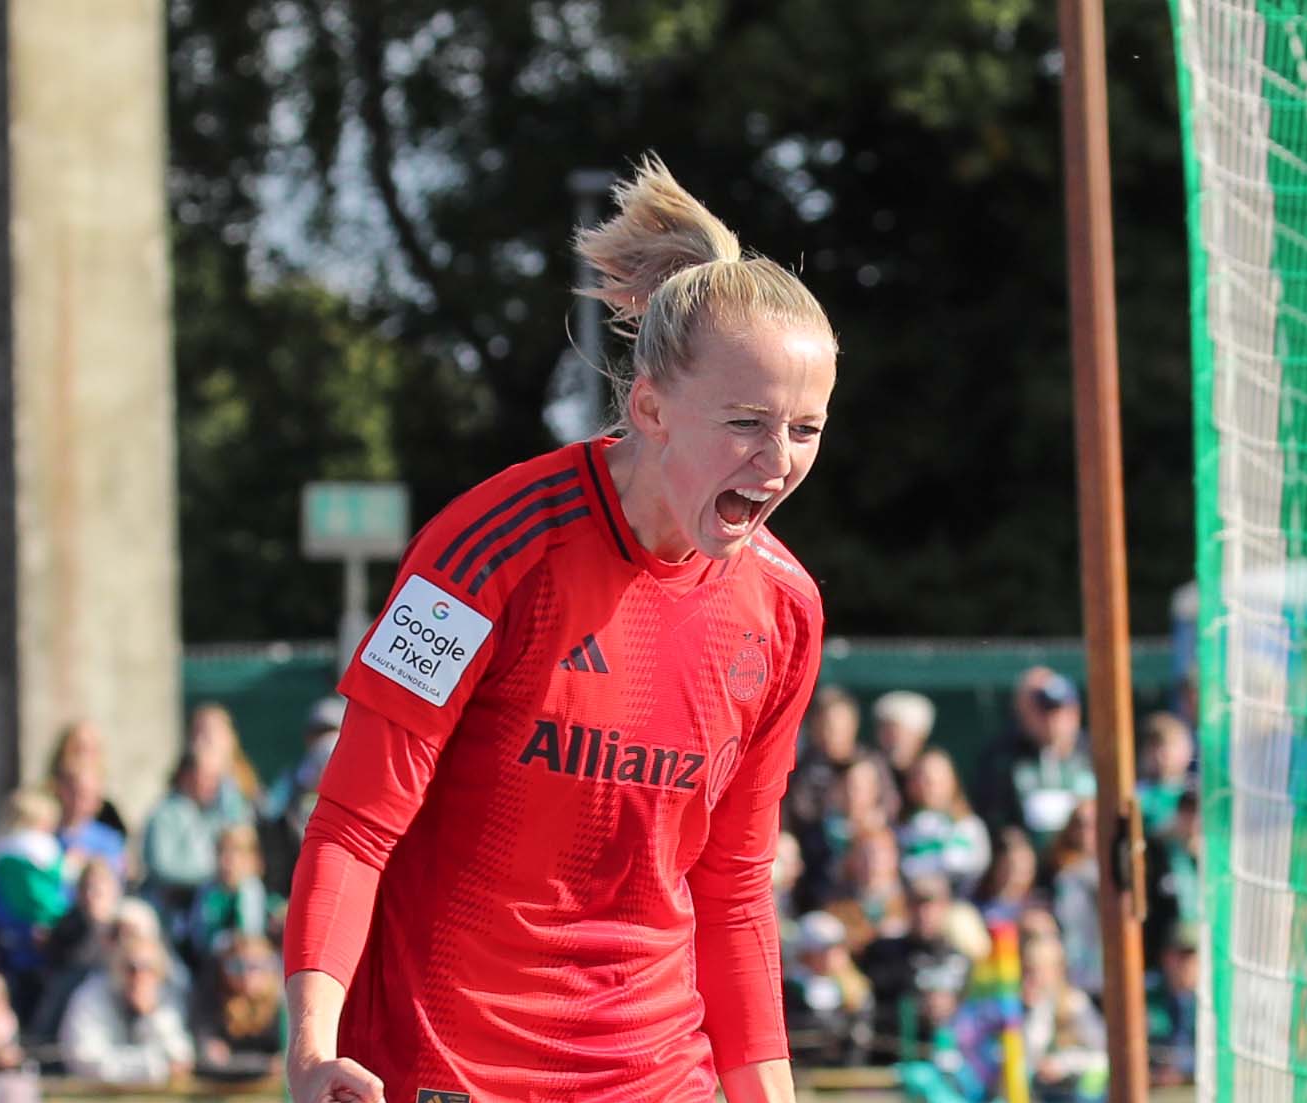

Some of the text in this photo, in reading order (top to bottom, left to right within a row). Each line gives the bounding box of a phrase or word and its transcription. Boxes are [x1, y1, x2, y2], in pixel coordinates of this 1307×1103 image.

[388, 635, 442, 679] Pixel
[392, 604, 465, 662] Google
[367, 651, 441, 698] FRAUEN-BUNDESLIGA
[517, 719, 706, 789] Allianz
